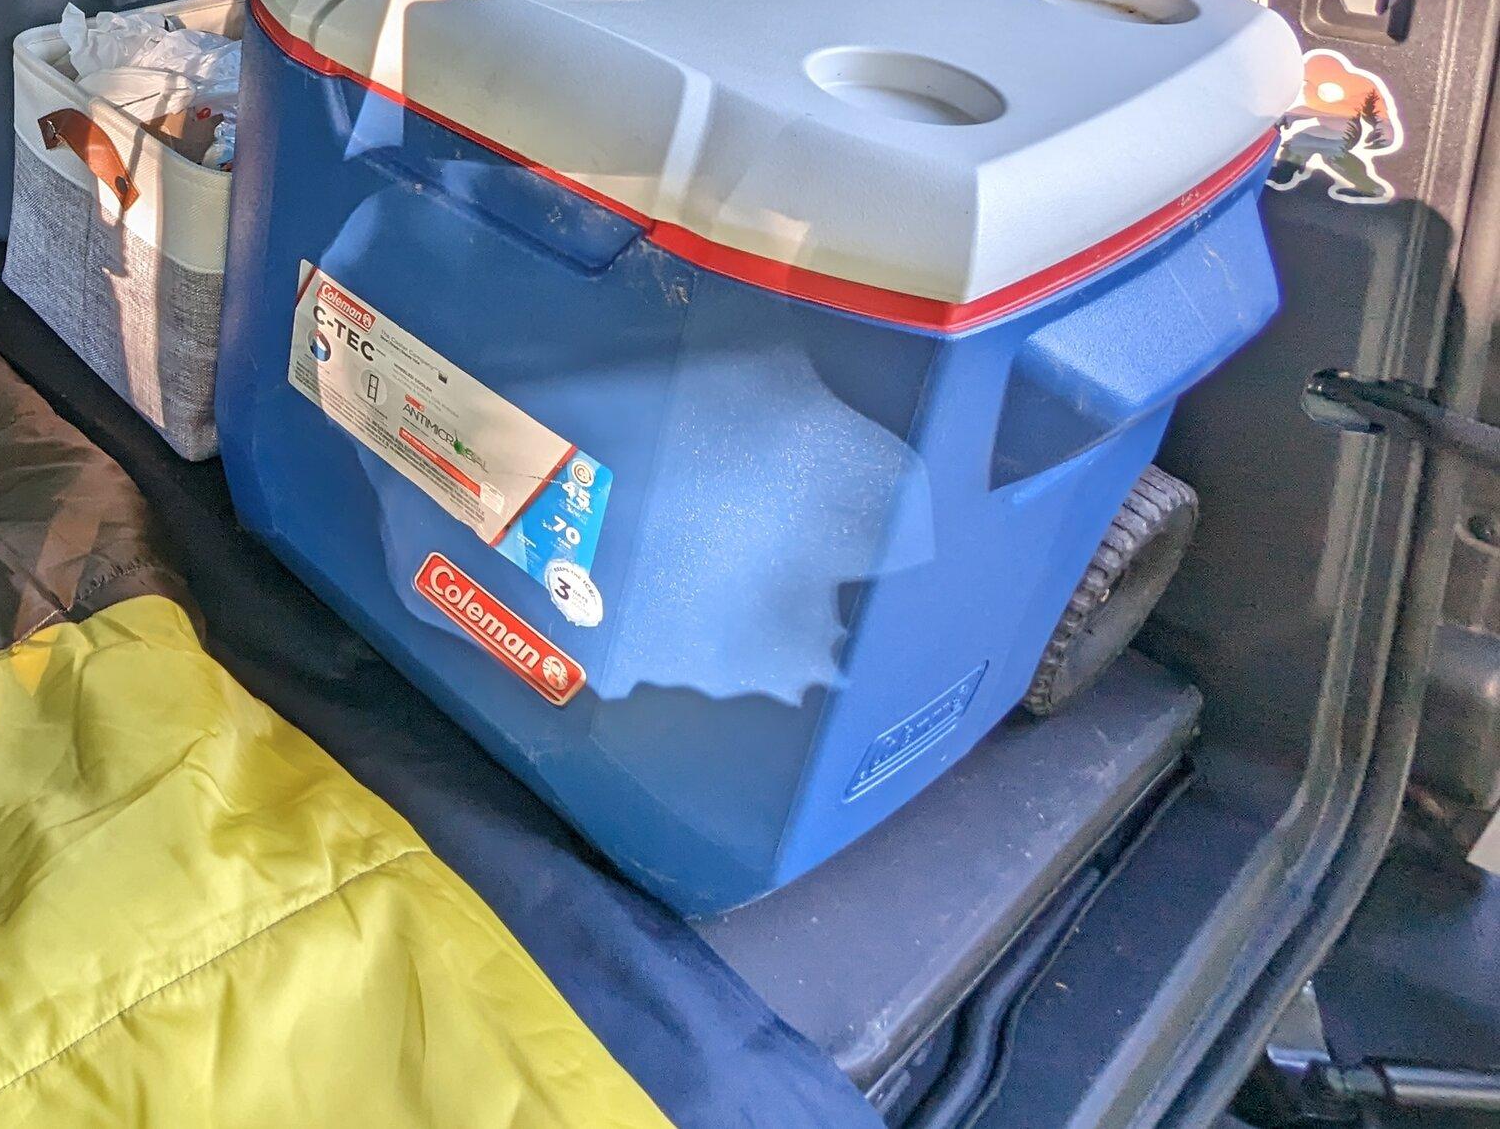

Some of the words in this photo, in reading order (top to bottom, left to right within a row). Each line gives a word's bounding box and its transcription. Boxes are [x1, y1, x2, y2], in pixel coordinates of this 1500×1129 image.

[322, 283, 362, 322] Coleman
[313, 304, 376, 362] C-TEC
[562, 481, 591, 510] 45
[553, 515, 581, 545] 70
[555, 576, 571, 600] 3
[429, 564, 541, 669] Coleman
